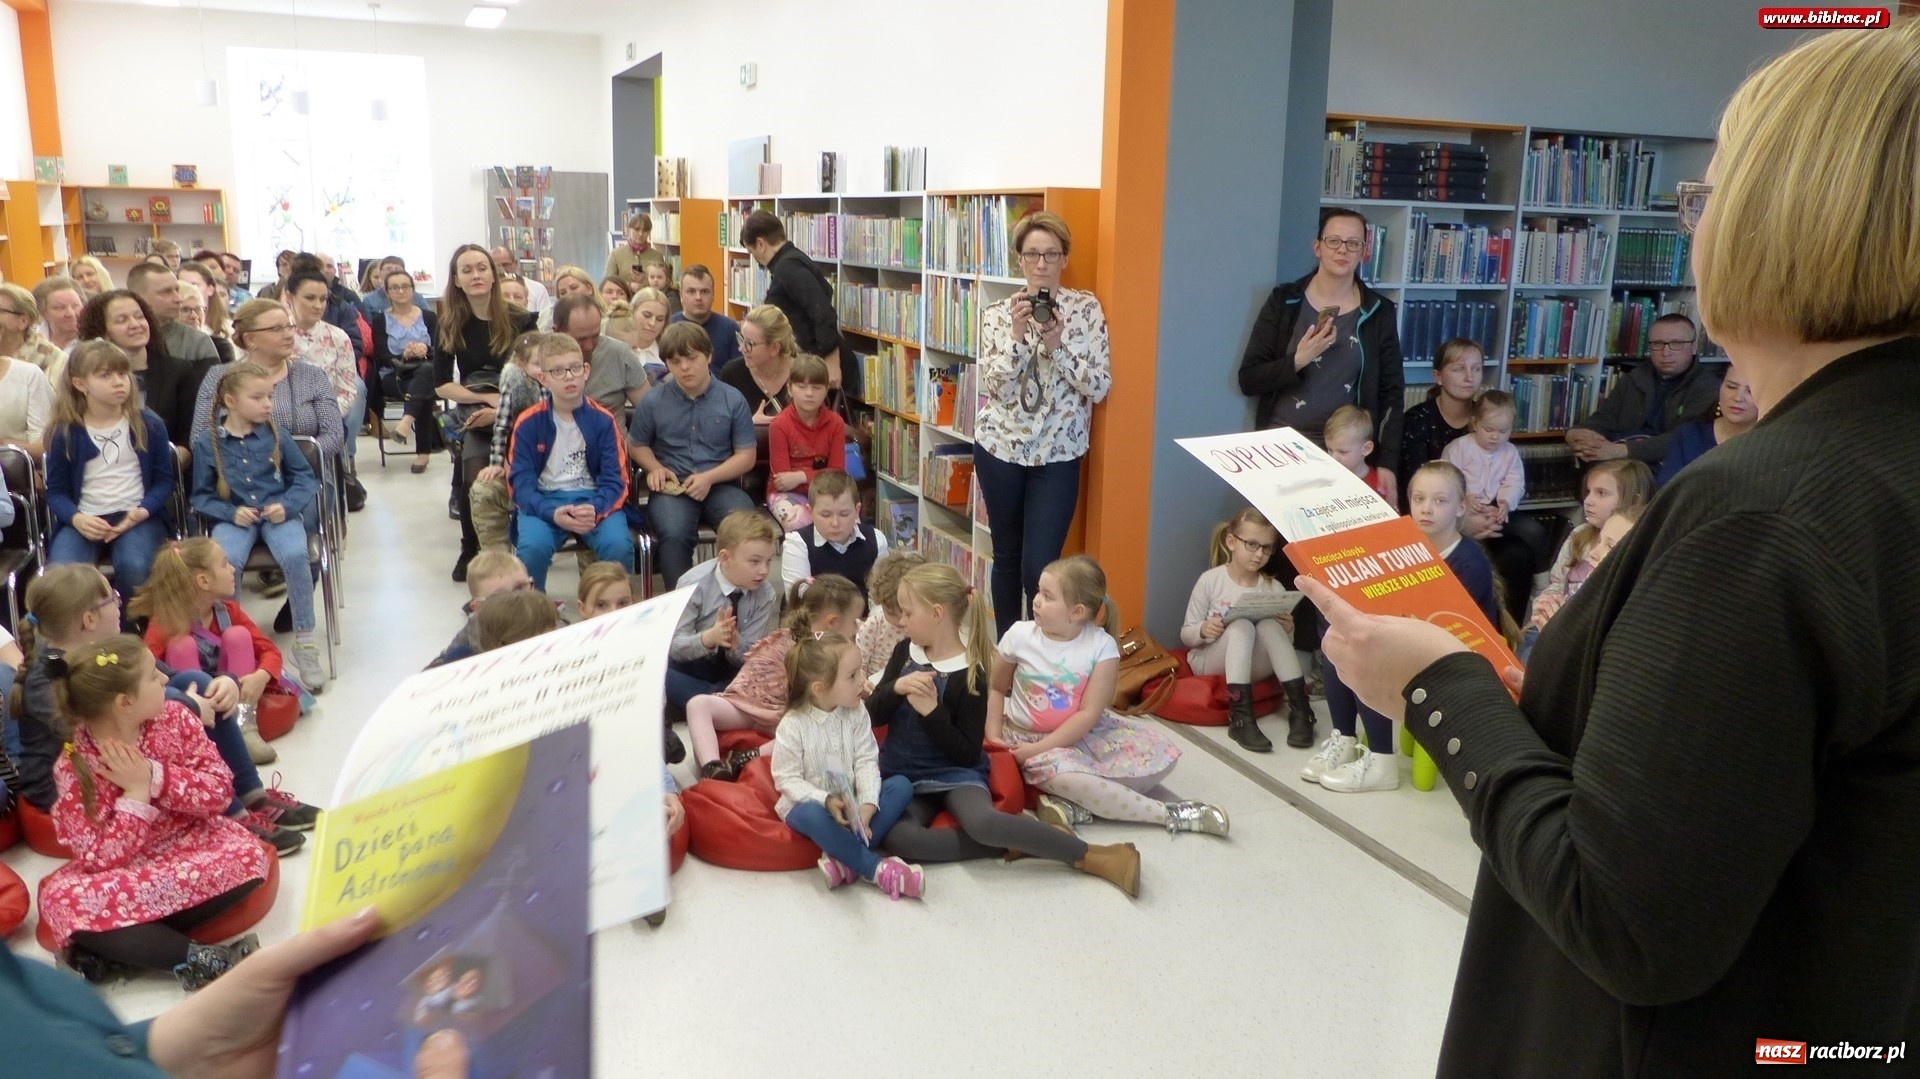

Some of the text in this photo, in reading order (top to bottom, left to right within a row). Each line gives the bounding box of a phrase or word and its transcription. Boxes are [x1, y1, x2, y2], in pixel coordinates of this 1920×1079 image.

[1210, 443, 1307, 473] DYPLOM
[1300, 493, 1378, 518] Za zajęcie III miejsca
[1312, 545, 1366, 566] Dziecięca klasyka
[1324, 541, 1434, 589] JULIAN TUWIM
[1361, 564, 1446, 600] WIERSZE DLA DZIECI
[535, 687, 548, 701] II
[557, 655, 646, 695] miejsca
[429, 688, 488, 715] Alicja
[334, 811, 419, 874] Dzieci
[397, 823, 455, 867] pana
